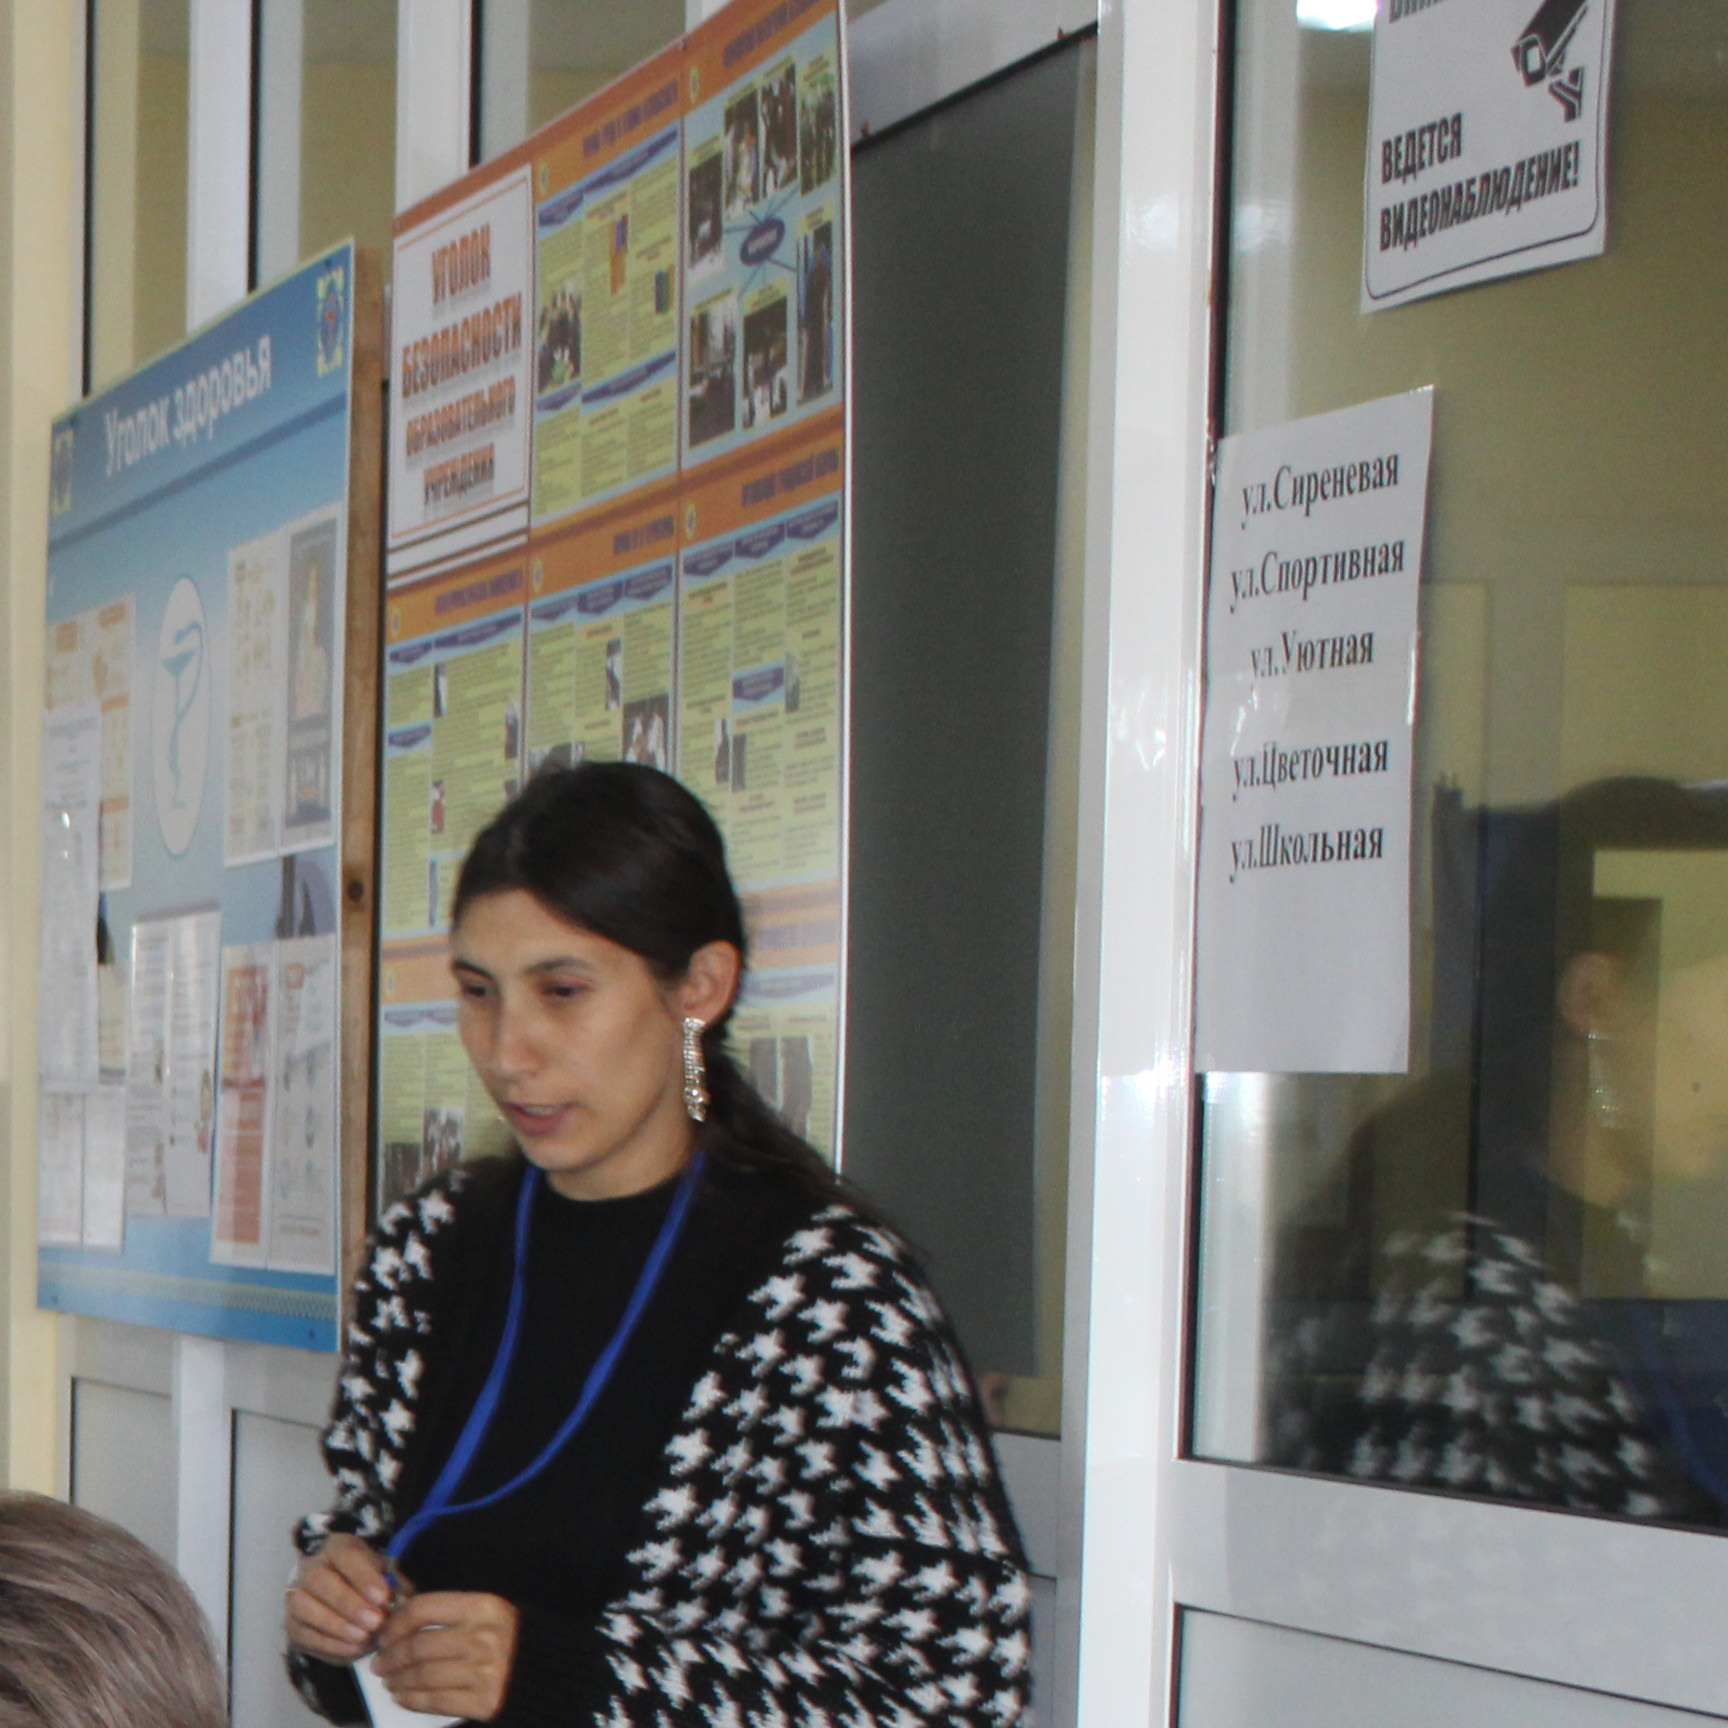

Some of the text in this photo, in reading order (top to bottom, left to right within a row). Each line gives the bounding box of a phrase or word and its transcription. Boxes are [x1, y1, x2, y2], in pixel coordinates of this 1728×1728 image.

[1382, 112, 1462, 184] ВЕДЕТСЯ
[1380, 141, 1580, 251] ВИДЕОНАБЛЮДЕНИЕ!
[432, 223, 491, 304] УГОЛОК
[402, 292, 522, 399] БЕЗОПАСНОСТИ
[104, 334, 272, 476] Уголок здоровья
[1241, 454, 1399, 528] ул.Сиреневая
[1230, 540, 1405, 613] ул.Спортивная
[1251, 630, 1375, 686] ул.Уютная
[1233, 739, 1388, 800] ул.Цветочная
[1230, 825, 1383, 882] ул.Школьная
